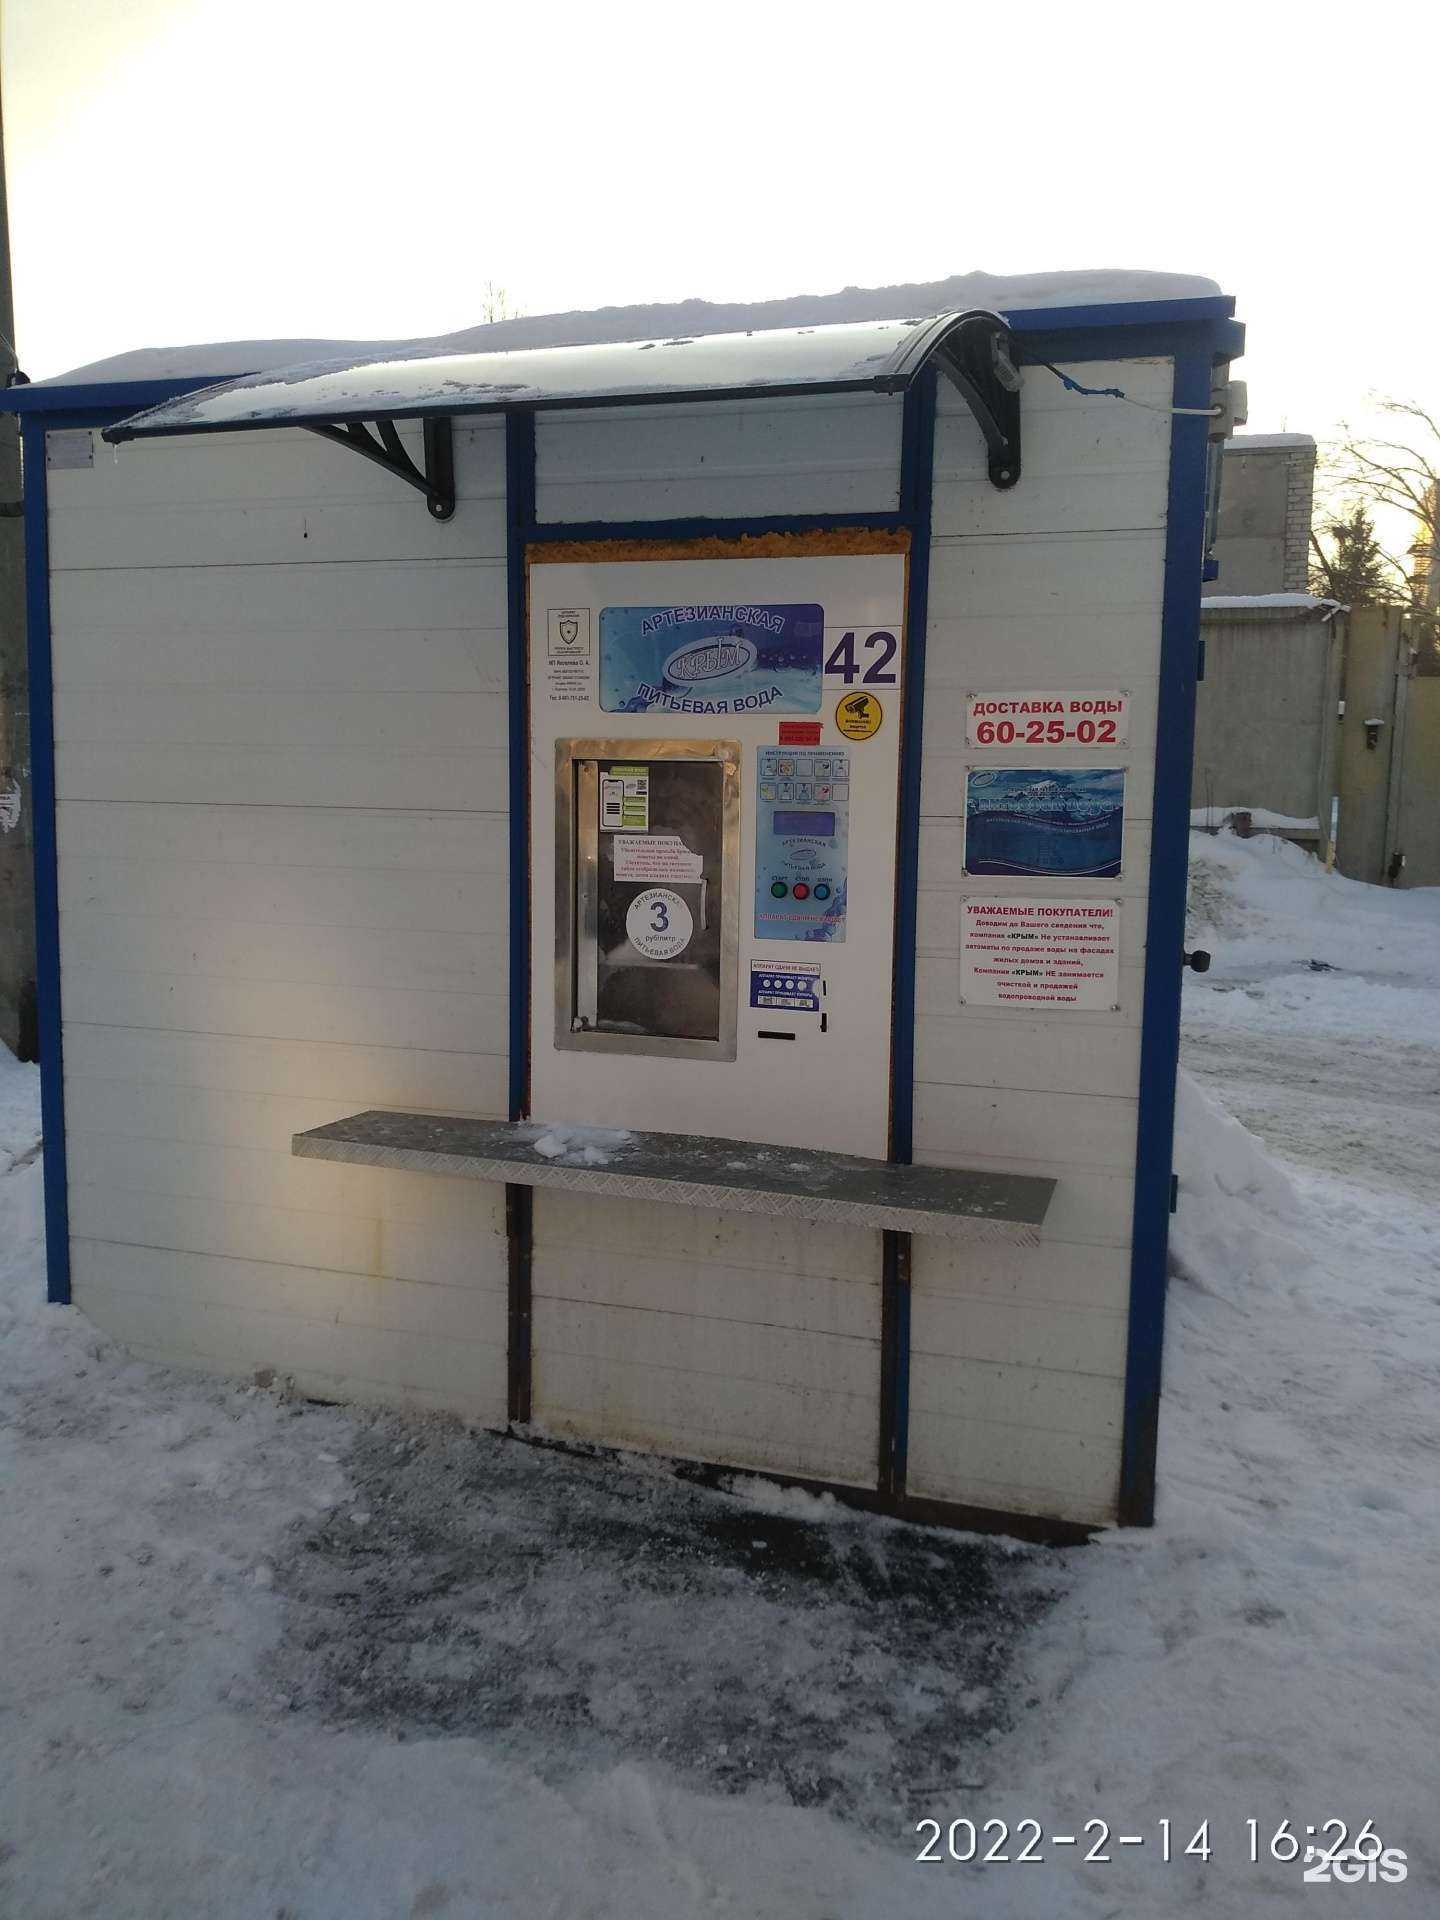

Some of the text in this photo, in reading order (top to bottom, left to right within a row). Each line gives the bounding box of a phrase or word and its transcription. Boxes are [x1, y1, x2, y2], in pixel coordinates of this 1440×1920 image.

[641, 606, 785, 635] АРТЕЗИАНСКАЯ
[824, 632, 897, 684] 42
[638, 683, 783, 714] ПИТЬЕВАЯ ВОДА
[973, 700, 1122, 716] ДОСТАВКА ВОДЫ
[977, 720, 1116, 744] 60-25-02
[650, 902, 669, 932] 3
[967, 906, 1113, 917] УВАЖАЕМЫЕ ПОКУПАТЕЛИ!
[976, 920, 1008, 928] Доводим
[1020, 921, 1049, 929] Вашего
[997, 980, 1031, 988] очисткой
[1040, 982, 1078, 990] продажей
[998, 993, 1055, 1001] водопроводной
